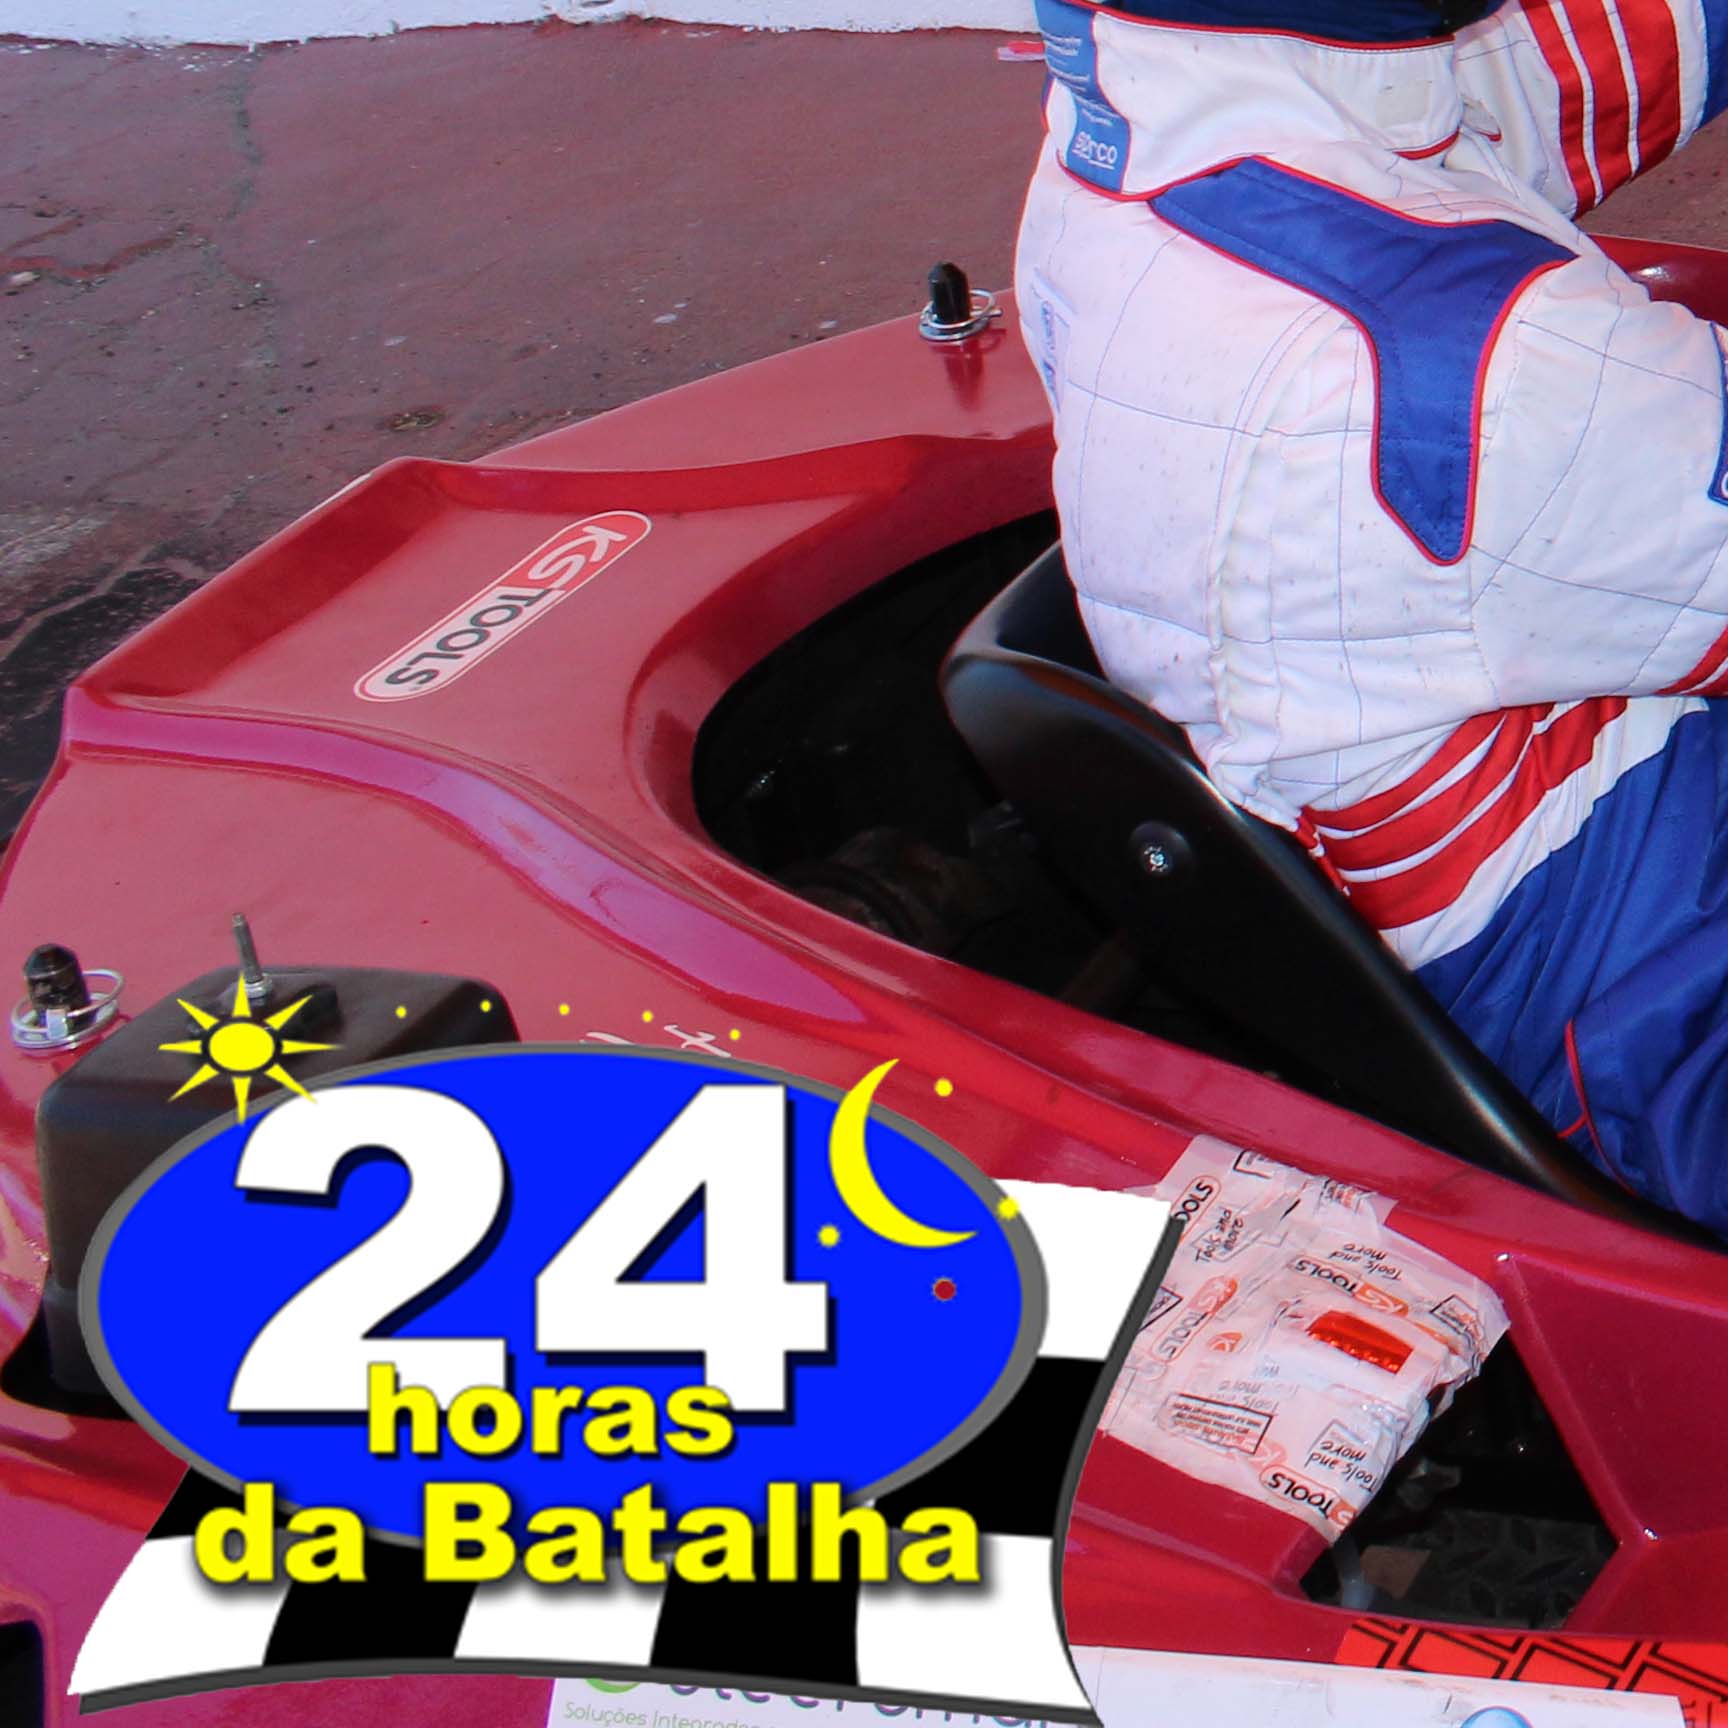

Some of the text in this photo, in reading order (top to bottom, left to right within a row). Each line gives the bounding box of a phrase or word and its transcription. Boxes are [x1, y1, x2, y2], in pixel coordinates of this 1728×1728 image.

[385, 524, 628, 686] KS TOOLS
[1295, 1259, 1358, 1294] TOOLS
[1304, 1452, 1340, 1468] and
[1320, 1440, 1367, 1462] more
[1268, 1472, 1333, 1520] TOOLS
[563, 1701, 648, 1726] Soluções
